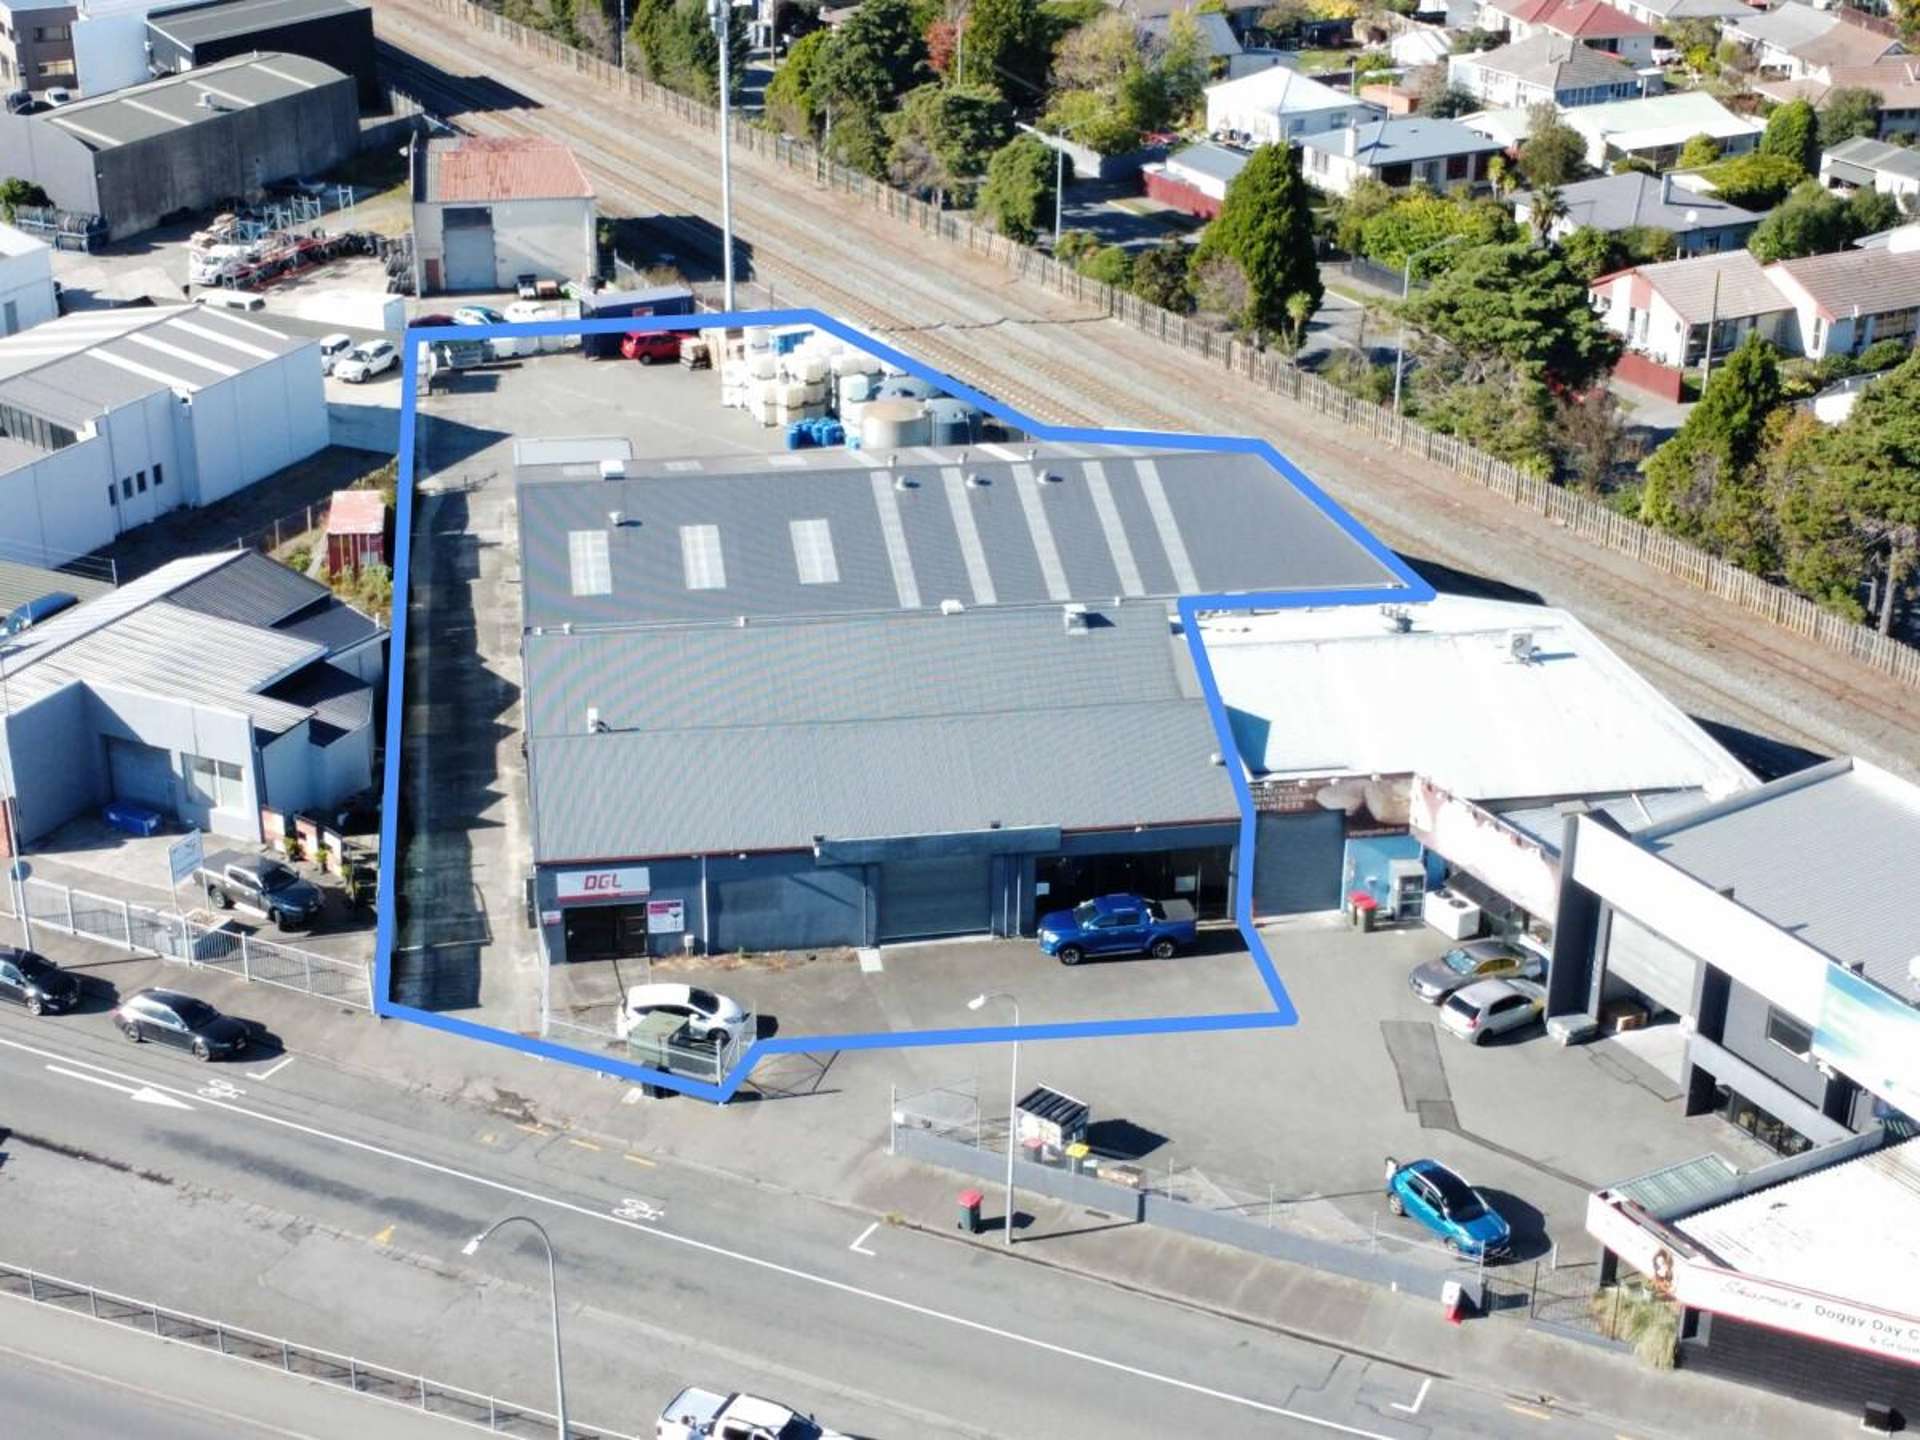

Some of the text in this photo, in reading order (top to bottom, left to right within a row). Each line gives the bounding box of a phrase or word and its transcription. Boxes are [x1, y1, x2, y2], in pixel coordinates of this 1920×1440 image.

[584, 873, 622, 890] DGL
[1815, 1304, 1866, 1328] Doggy
[1872, 1319, 1903, 1337] Day
